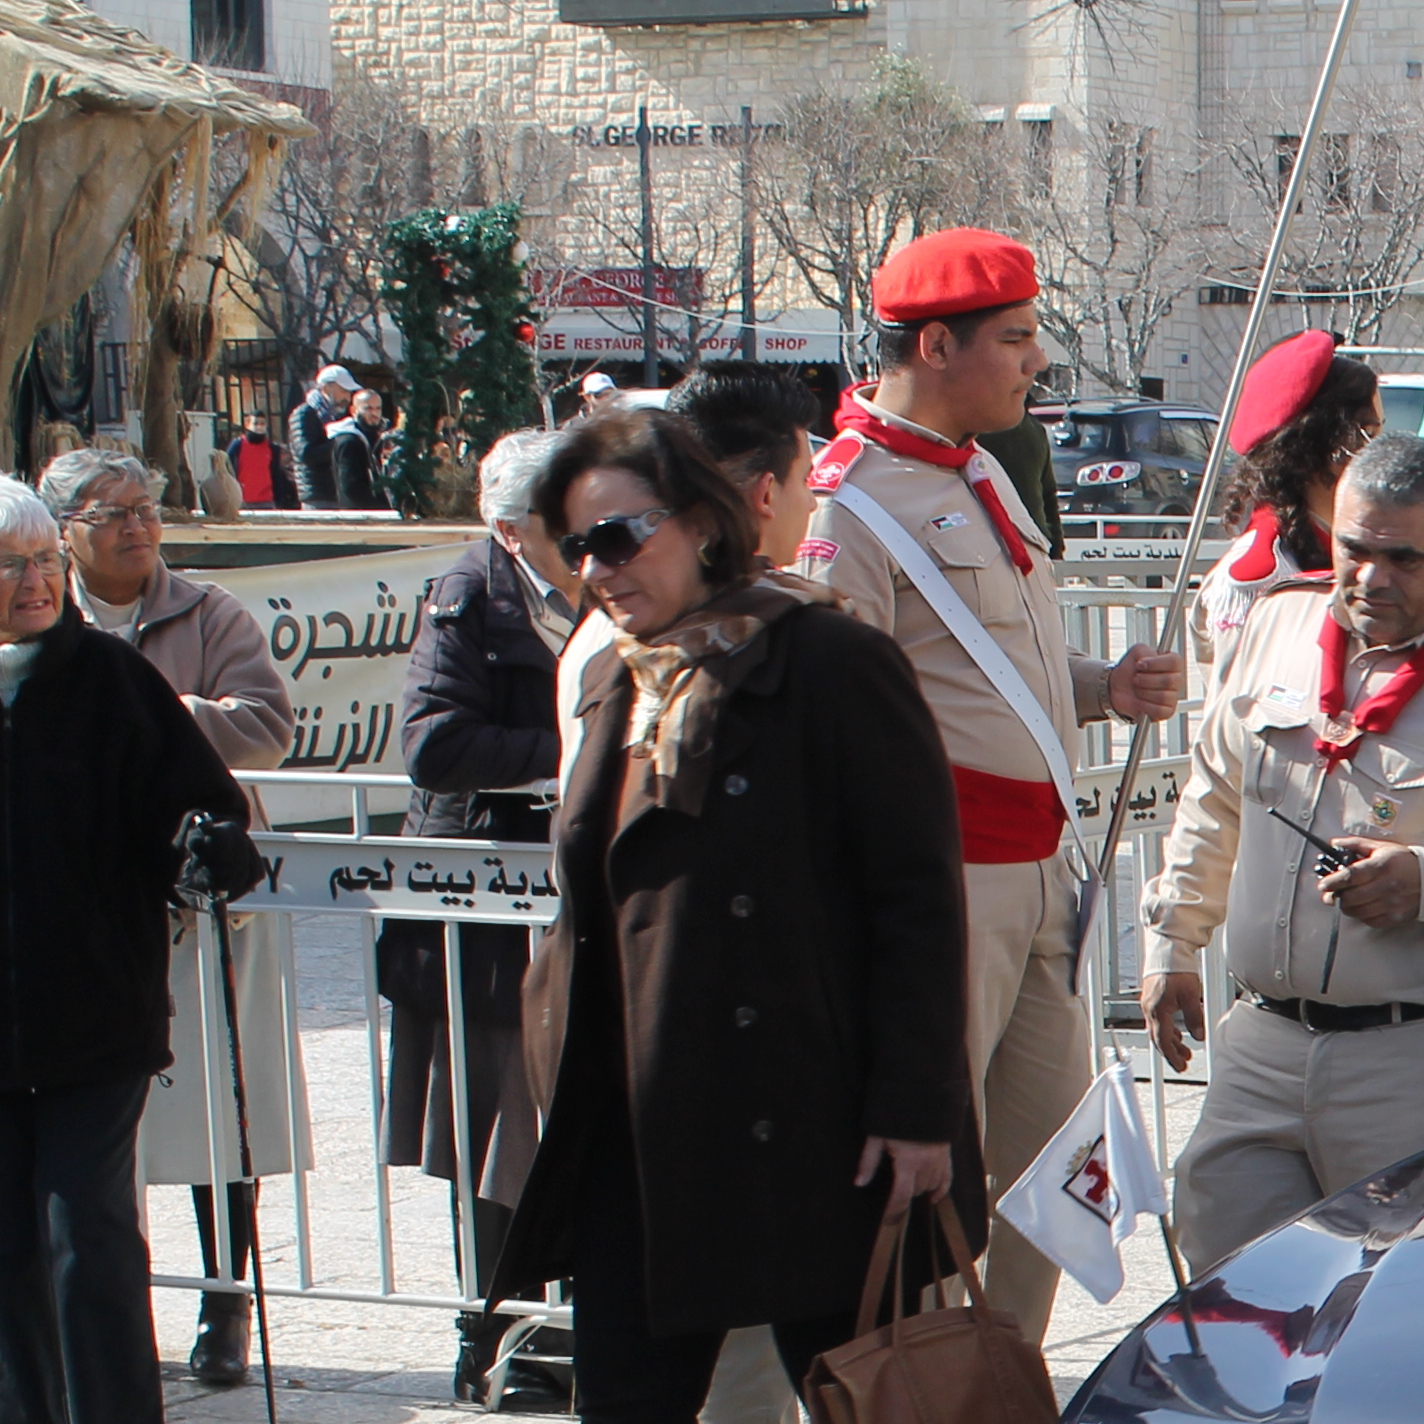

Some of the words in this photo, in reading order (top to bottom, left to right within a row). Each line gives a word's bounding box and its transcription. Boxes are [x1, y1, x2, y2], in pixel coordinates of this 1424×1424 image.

[574, 337, 673, 350] RESTAURNT
[700, 337, 744, 350] COFF
[765, 338, 808, 350] SHOP
[1143, 544, 1182, 559] لدية
[268, 580, 425, 681] لشجرة
[329, 857, 395, 901] لحم
[407, 861, 476, 908] بيت
[483, 856, 560, 911] لدية
